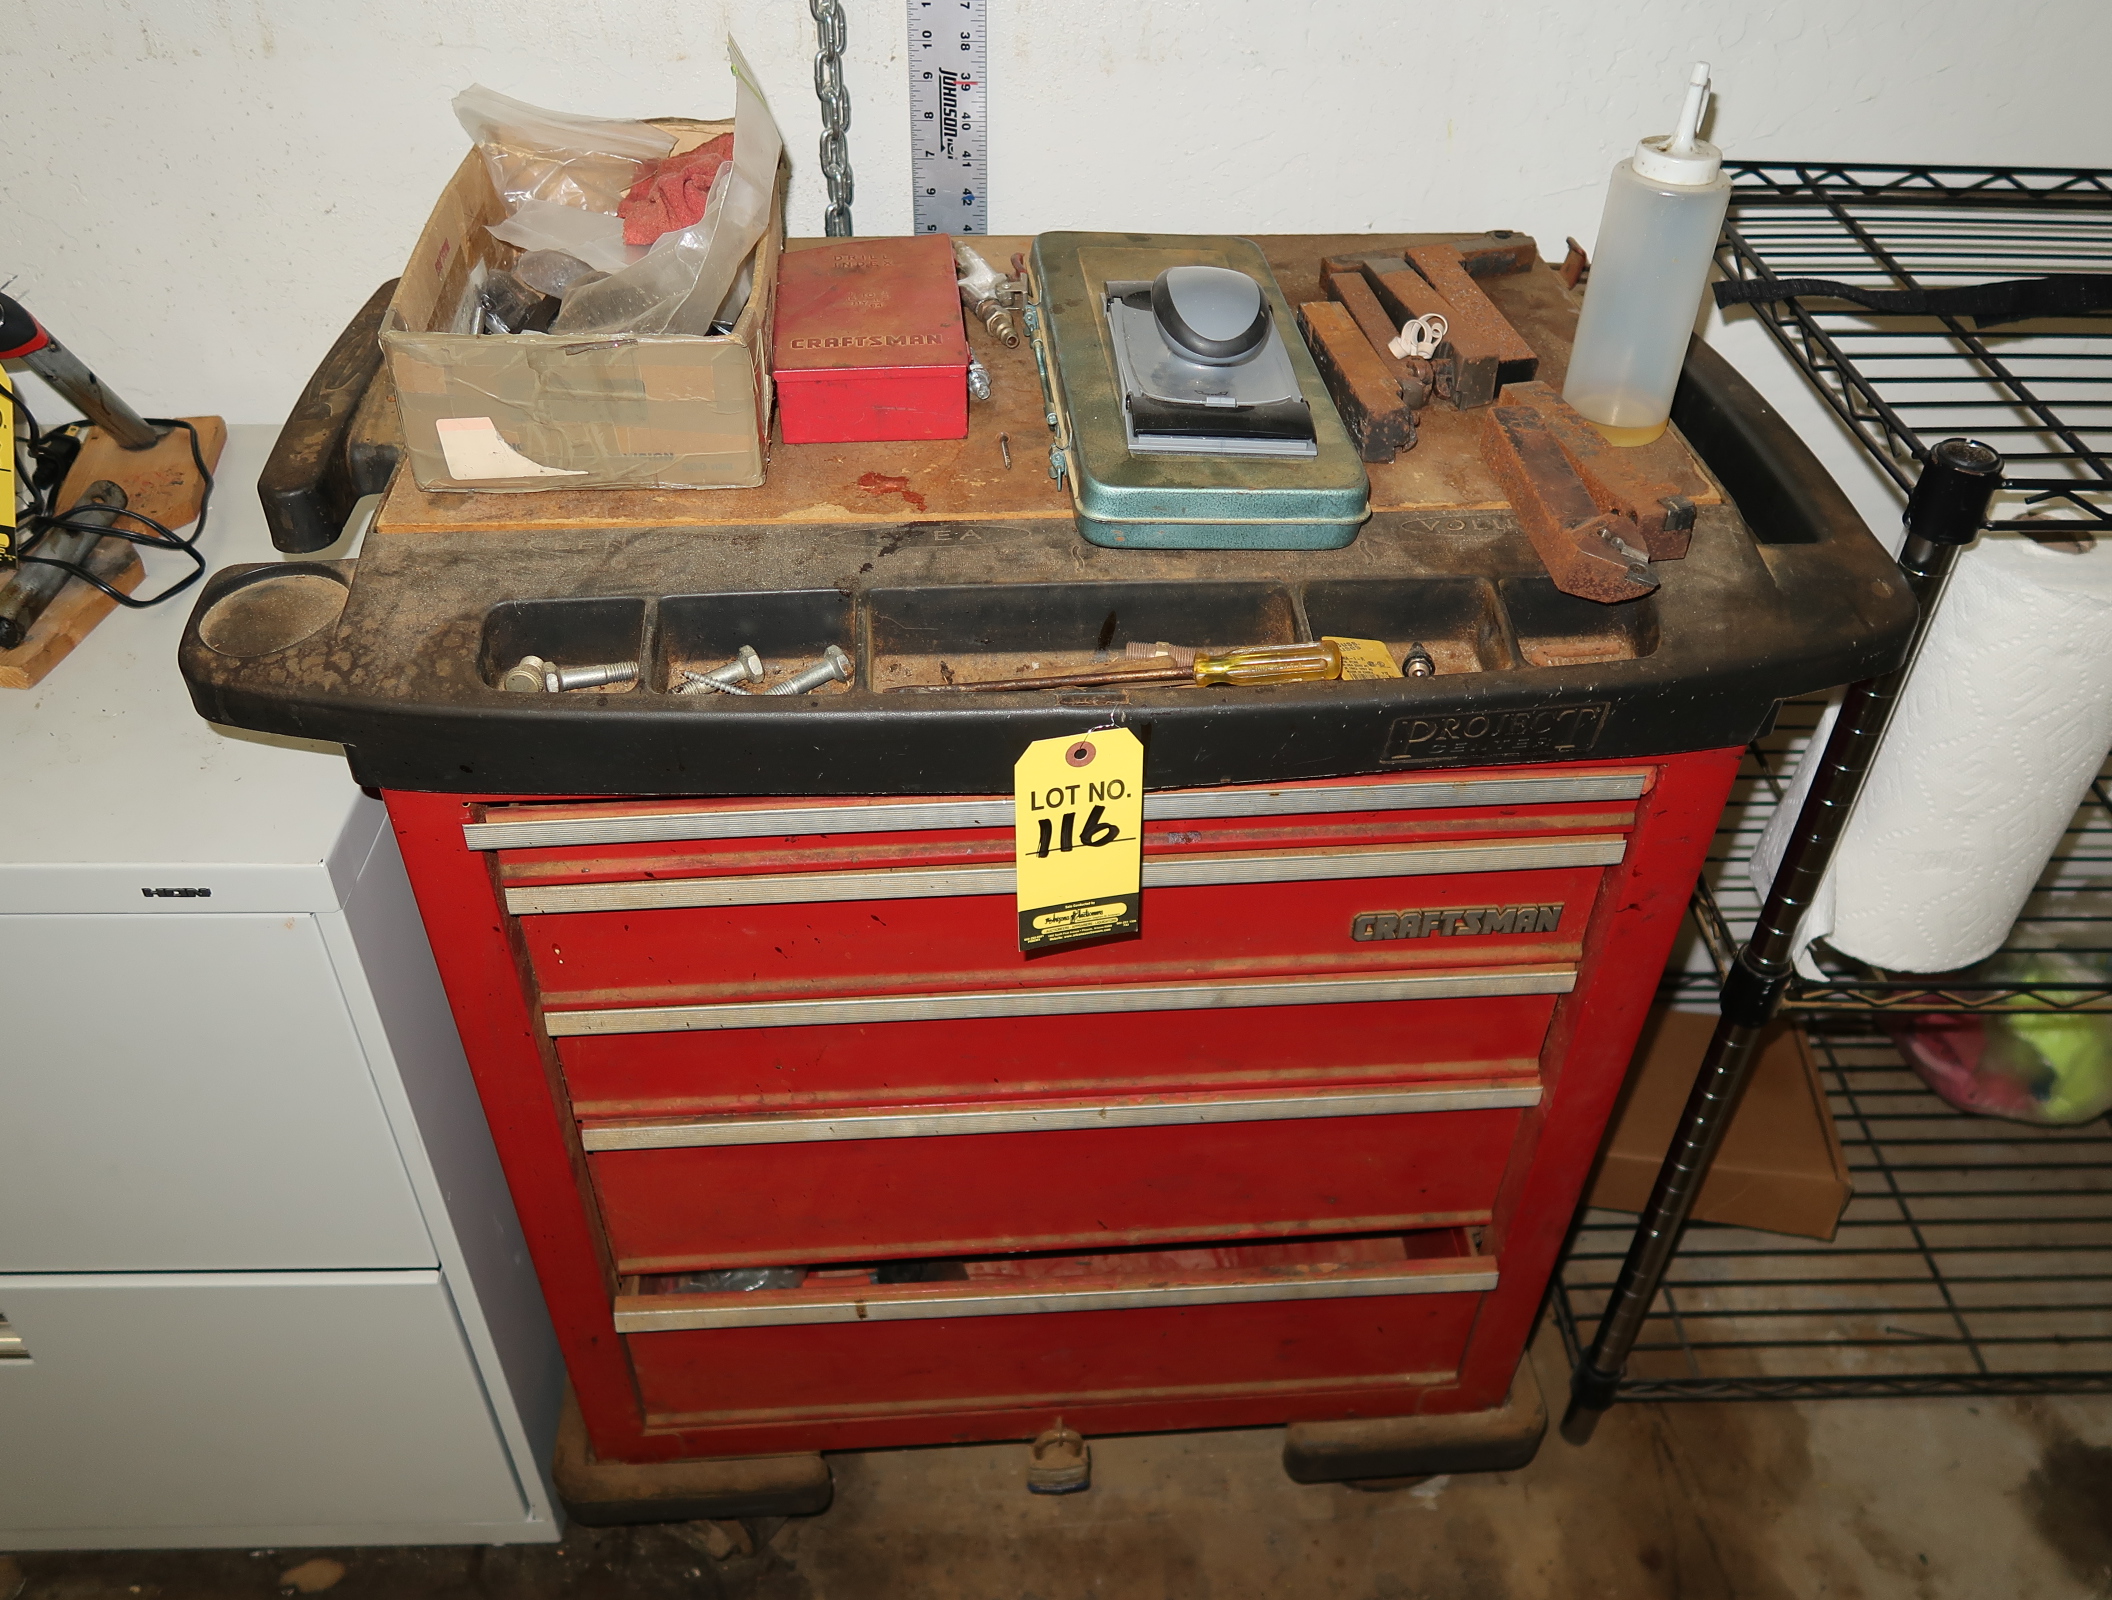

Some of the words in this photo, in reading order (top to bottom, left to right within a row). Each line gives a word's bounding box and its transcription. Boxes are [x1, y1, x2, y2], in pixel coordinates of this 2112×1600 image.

[960, 31, 971, 51] 38
[960, 72, 971, 92] 39
[938, 66, 959, 138] JOHNSON
[924, 111, 935, 120] 8
[961, 111, 972, 131] 40
[962, 150, 972, 168] 41
[962, 187, 973, 207] 42
[927, 224, 937, 232] 5
[833, 260, 892, 269] INDEX
[790, 333, 944, 350] CRAFTSMAN
[1390, 707, 1600, 759] PROJECT
[1030, 784, 1081, 811] LOT
[1088, 779, 1132, 803] NO.
[1036, 804, 1121, 859] 116
[141, 887, 212, 898] HON
[1351, 902, 1565, 942] CRAFTSMAN
